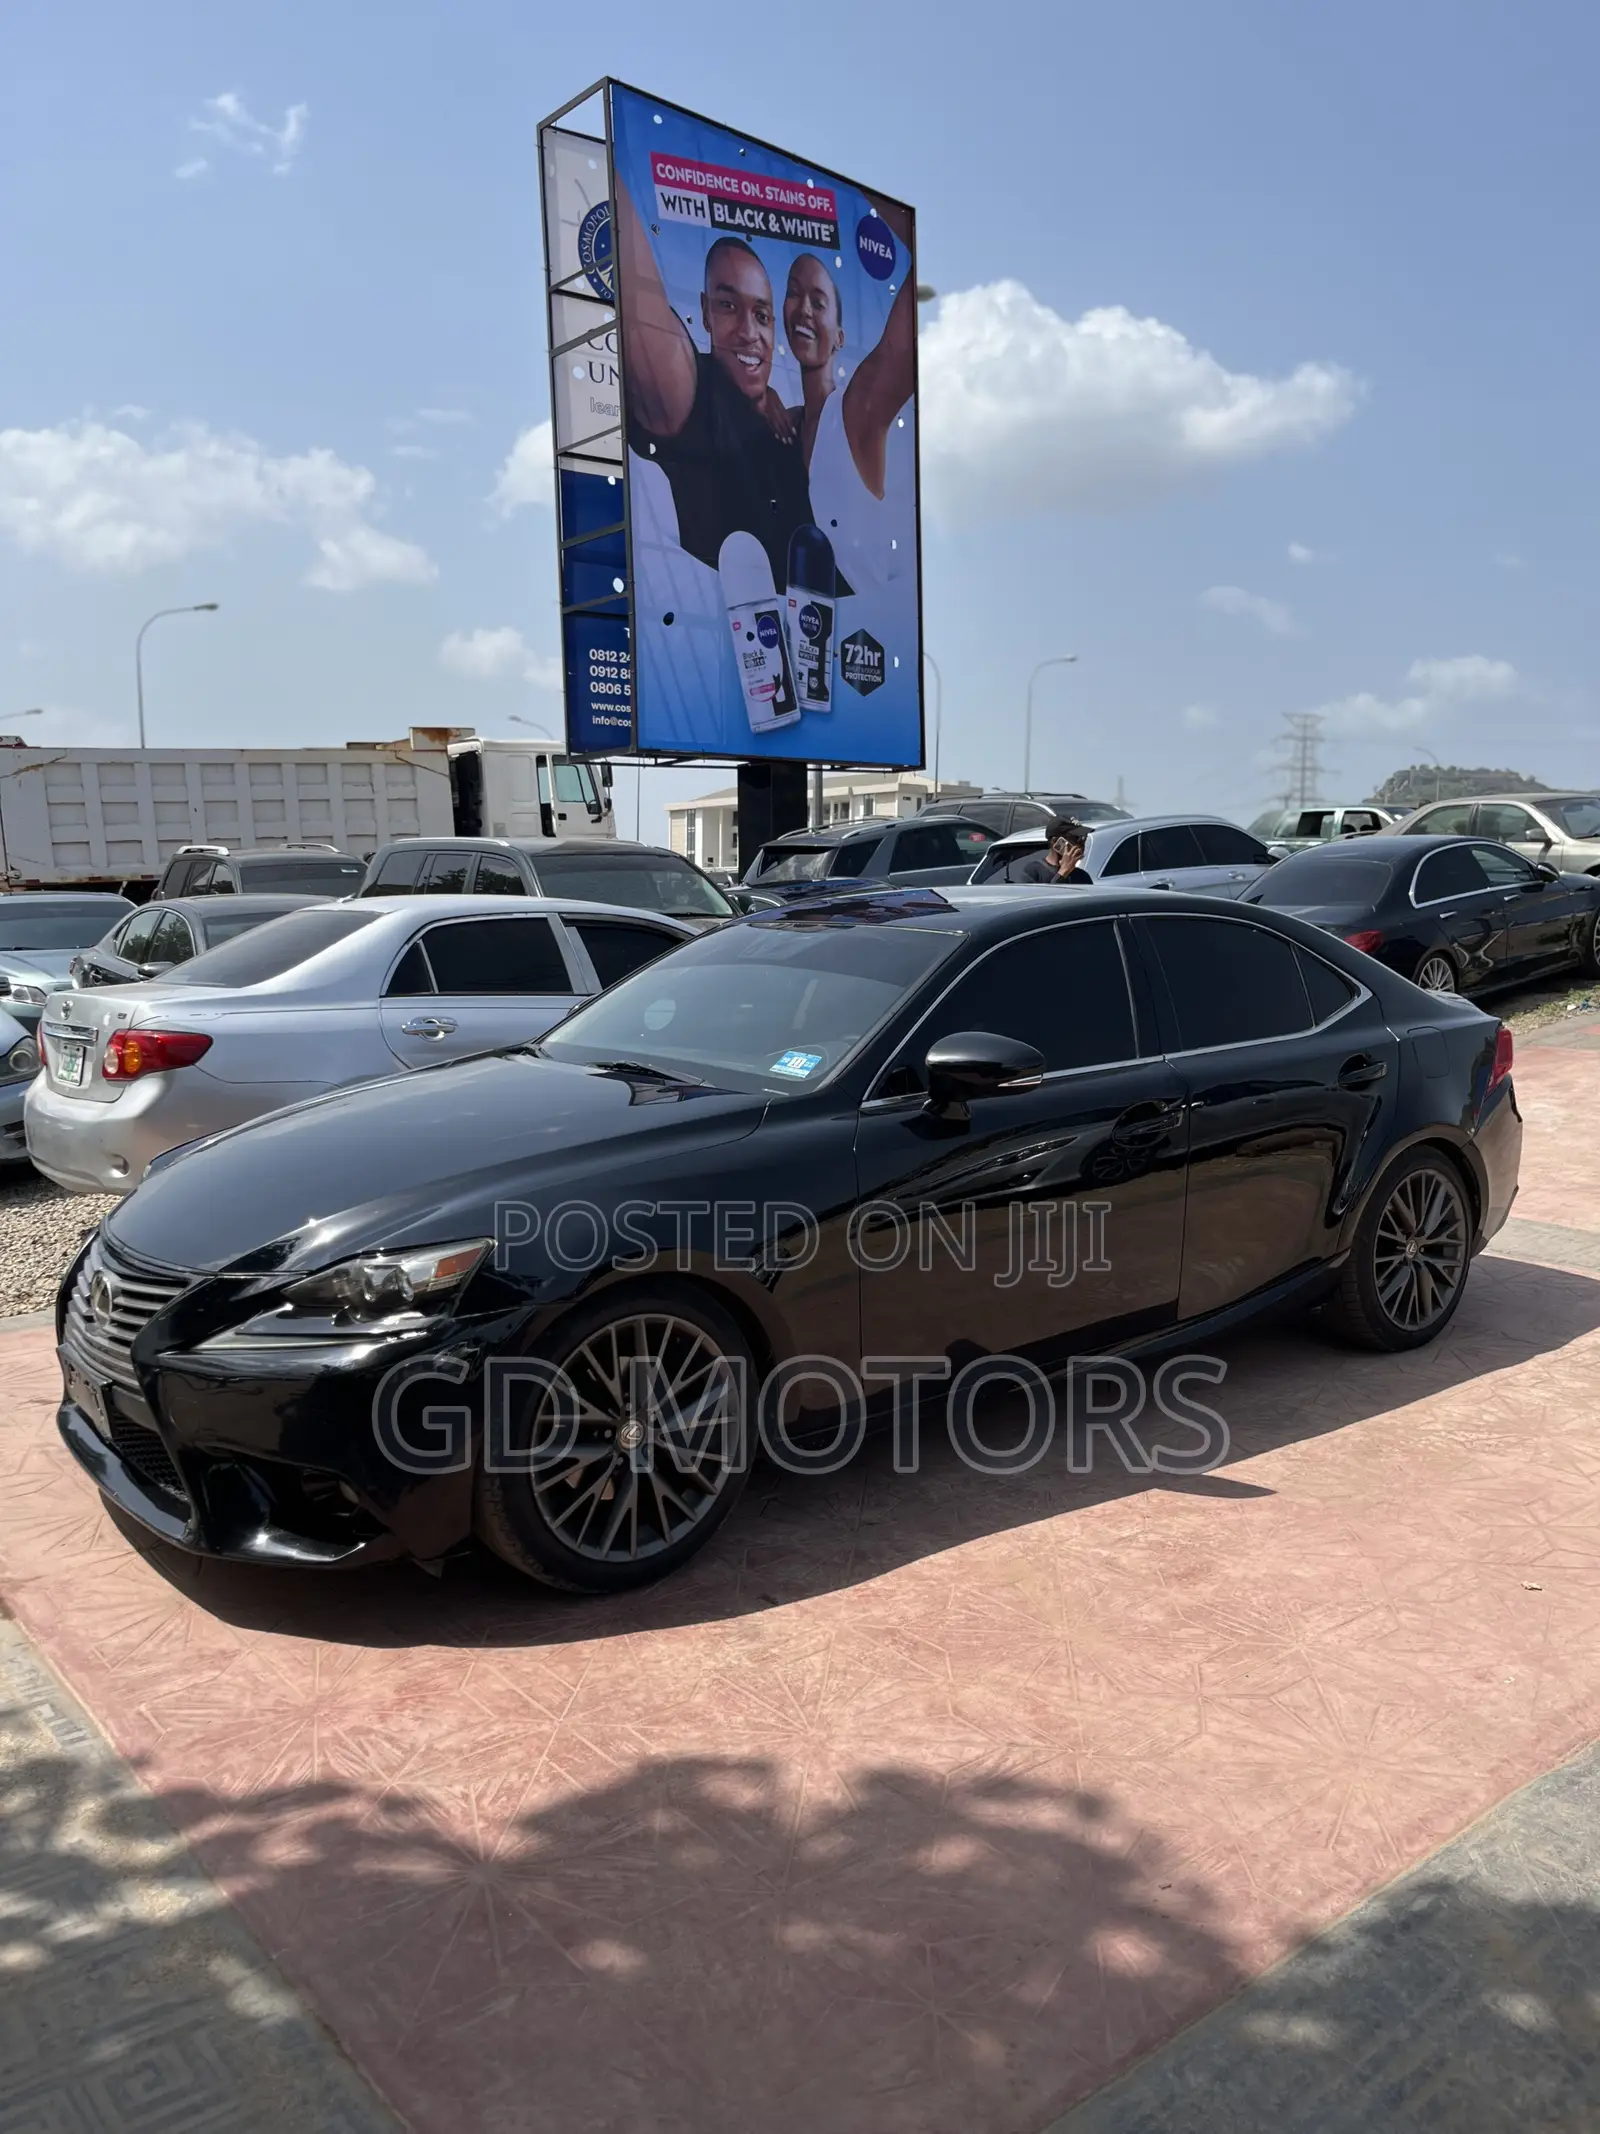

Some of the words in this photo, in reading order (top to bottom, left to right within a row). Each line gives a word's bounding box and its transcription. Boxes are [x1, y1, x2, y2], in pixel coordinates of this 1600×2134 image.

[656, 162, 739, 194] CONFIDENCE
[741, 181, 764, 199] ON.
[764, 186, 806, 208] STAINS
[807, 194, 833, 213] OFF.
[659, 192, 706, 219] WITH
[713, 202, 766, 230] BLACK
[768, 214, 781, 234] &
[859, 235, 894, 262] NIVEA
[759, 628, 777, 638] NIVEA
[589, 648, 618, 663] 0812
[844, 643, 881, 667] 72hr
[589, 665, 619, 680] 0912
[845, 671, 882, 683] PROTECTION
[590, 681, 622, 696] 0806
